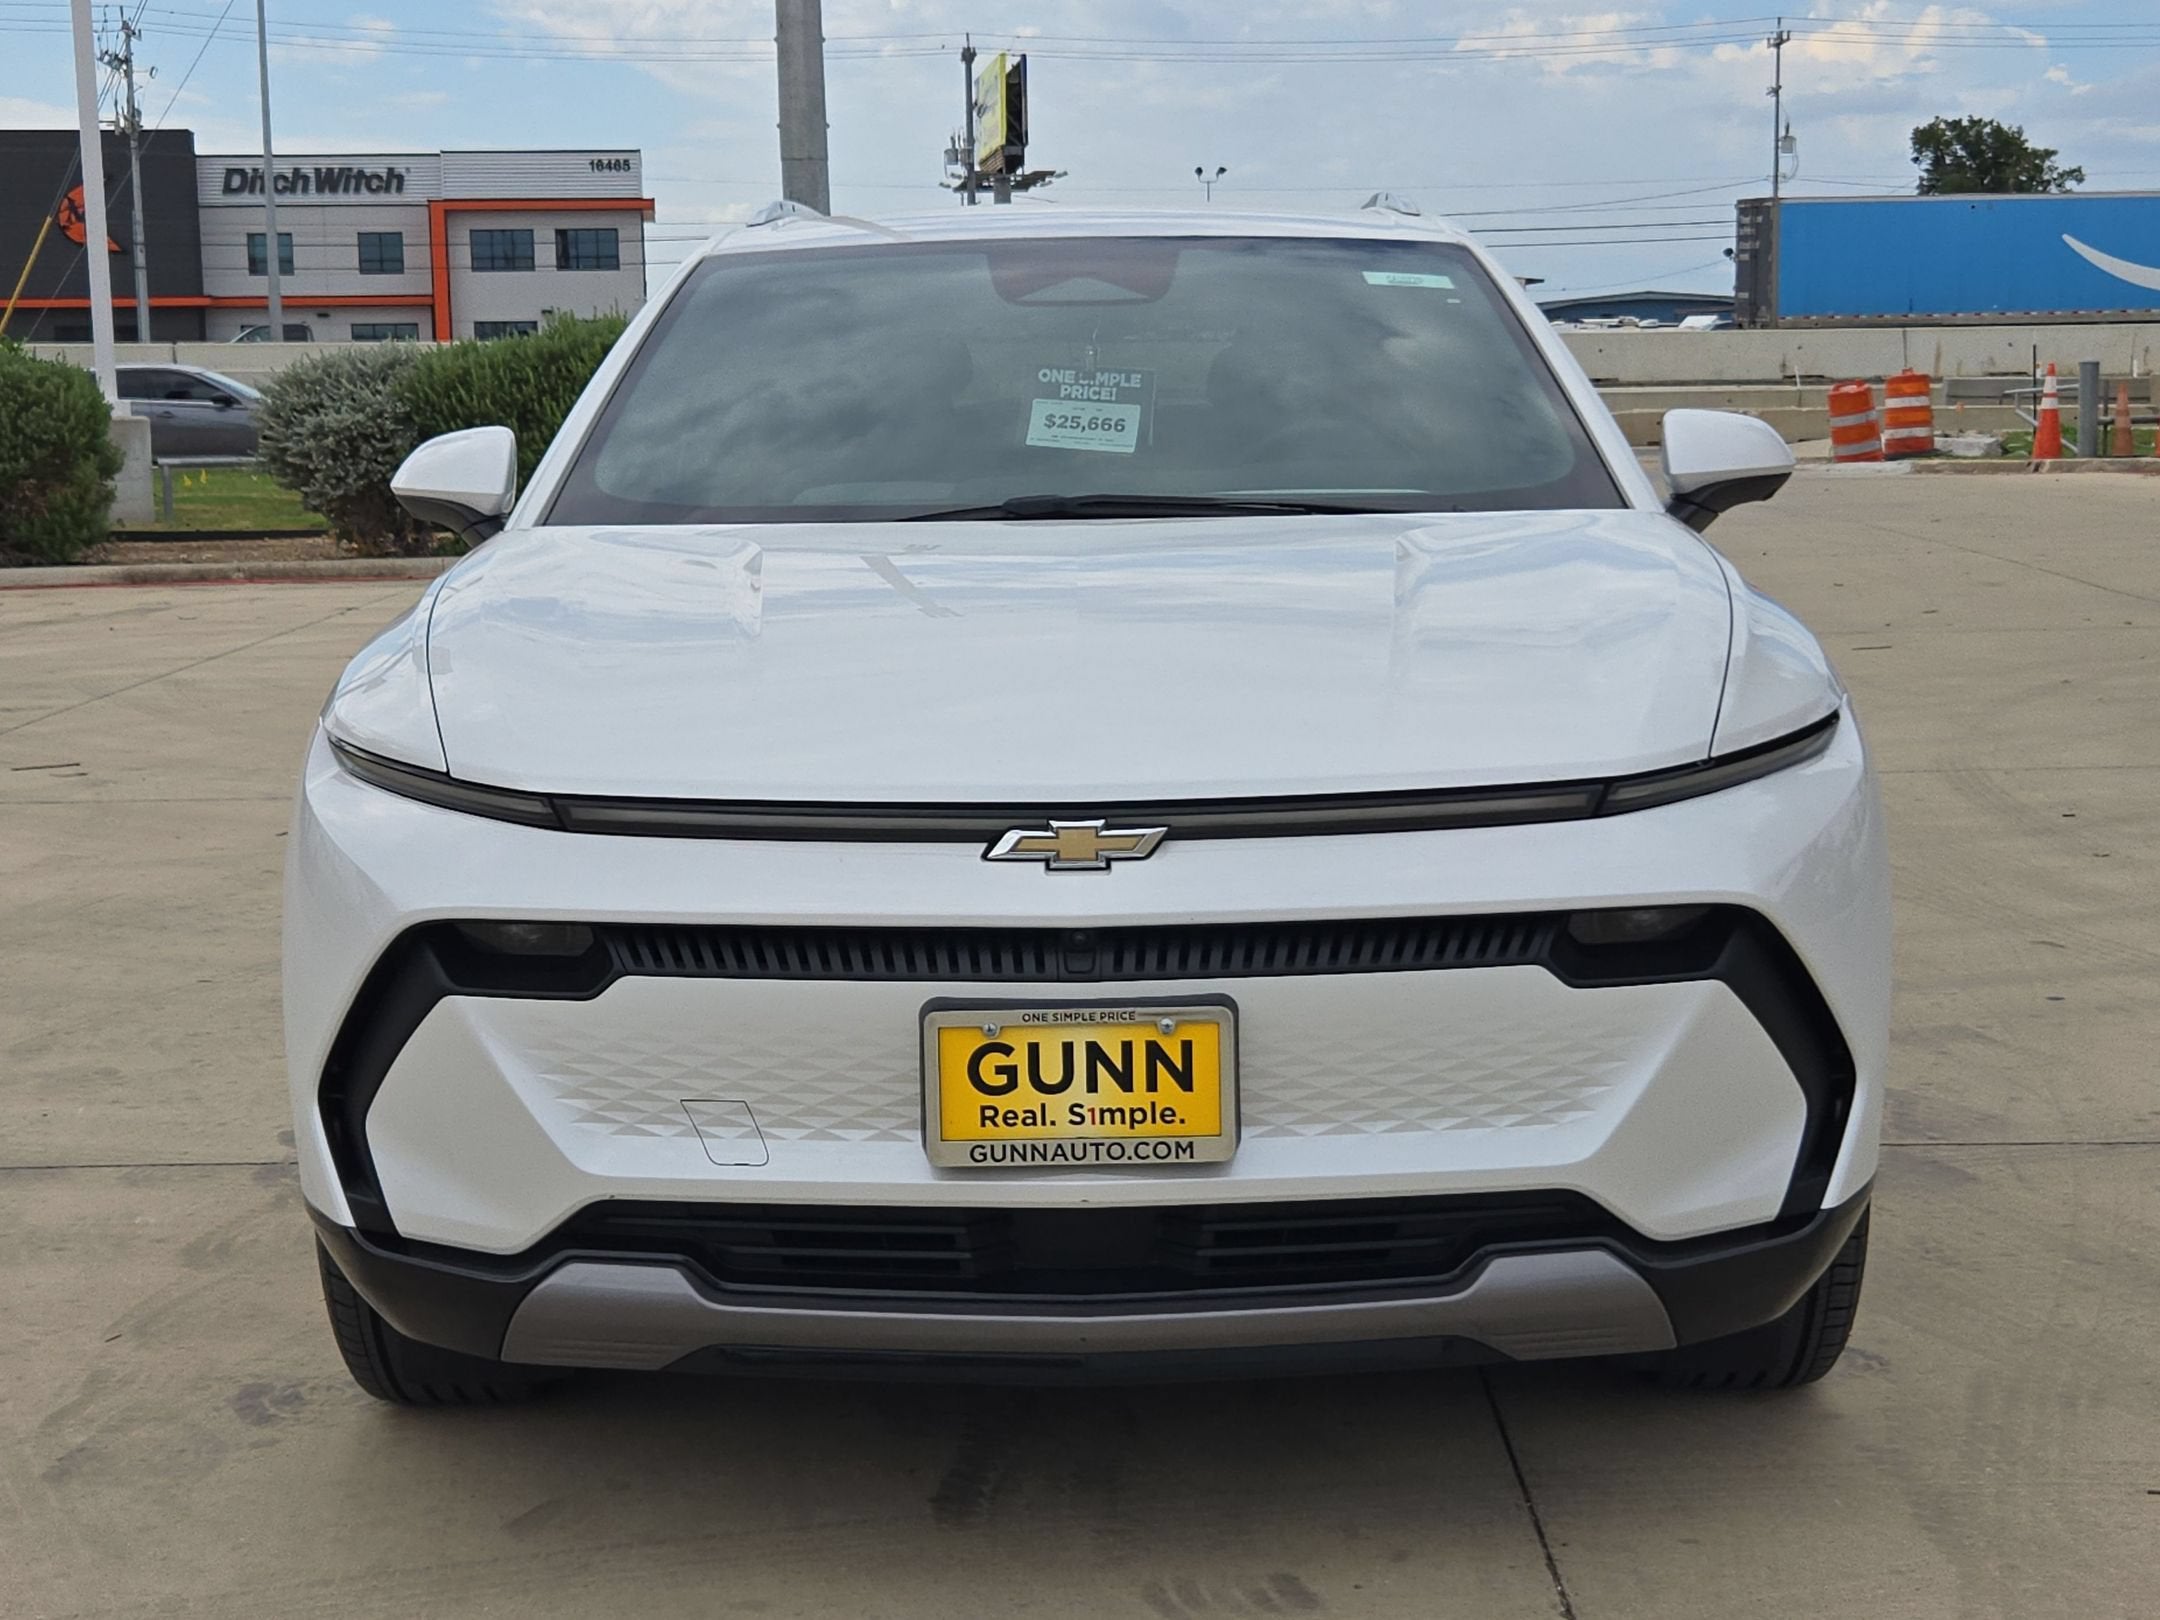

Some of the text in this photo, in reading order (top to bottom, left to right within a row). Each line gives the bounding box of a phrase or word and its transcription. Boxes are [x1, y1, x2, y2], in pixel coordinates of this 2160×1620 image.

[314, 167, 405, 195] Witch
[1038, 368, 1142, 388] ONE MPLE
[1043, 413, 1127, 433] $25,666
[1022, 1011, 1136, 1023] ONE SIMPLE PRICE
[967, 1039, 1194, 1096] GUNN
[979, 1102, 1056, 1128] Real.
[969, 1140, 1195, 1163] GUNNAUTO.COM
